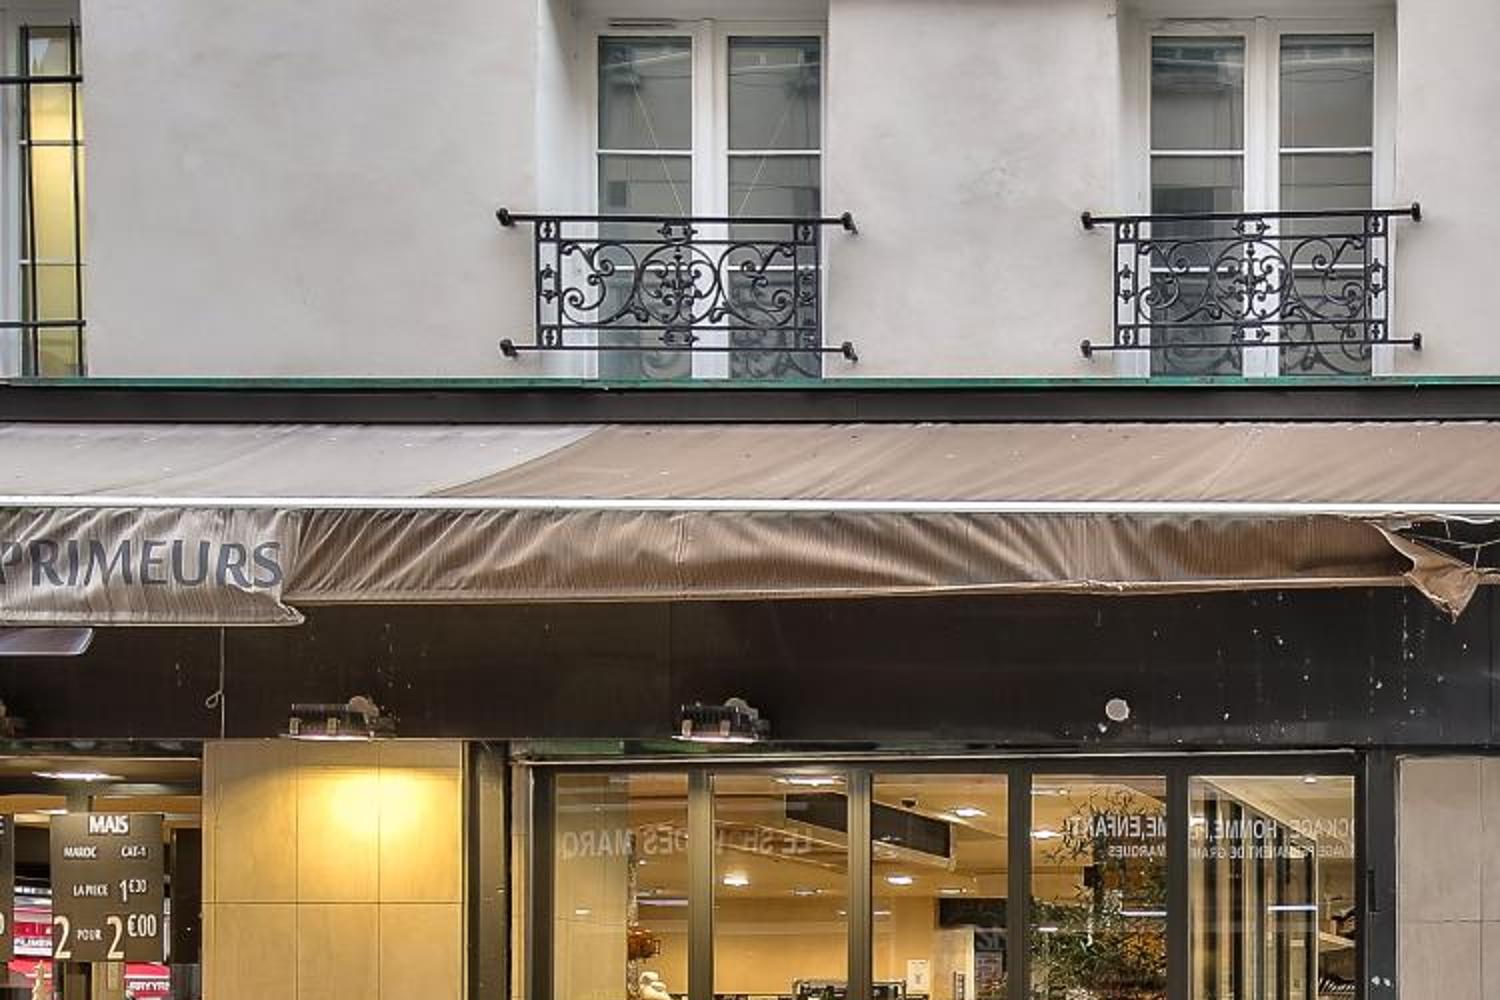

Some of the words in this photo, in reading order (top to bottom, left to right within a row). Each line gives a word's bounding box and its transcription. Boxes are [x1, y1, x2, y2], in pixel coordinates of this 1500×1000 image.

[88, 815, 129, 834] MAIS
[53, 915, 72, 960] 2
[77, 929, 102, 941] POUR
